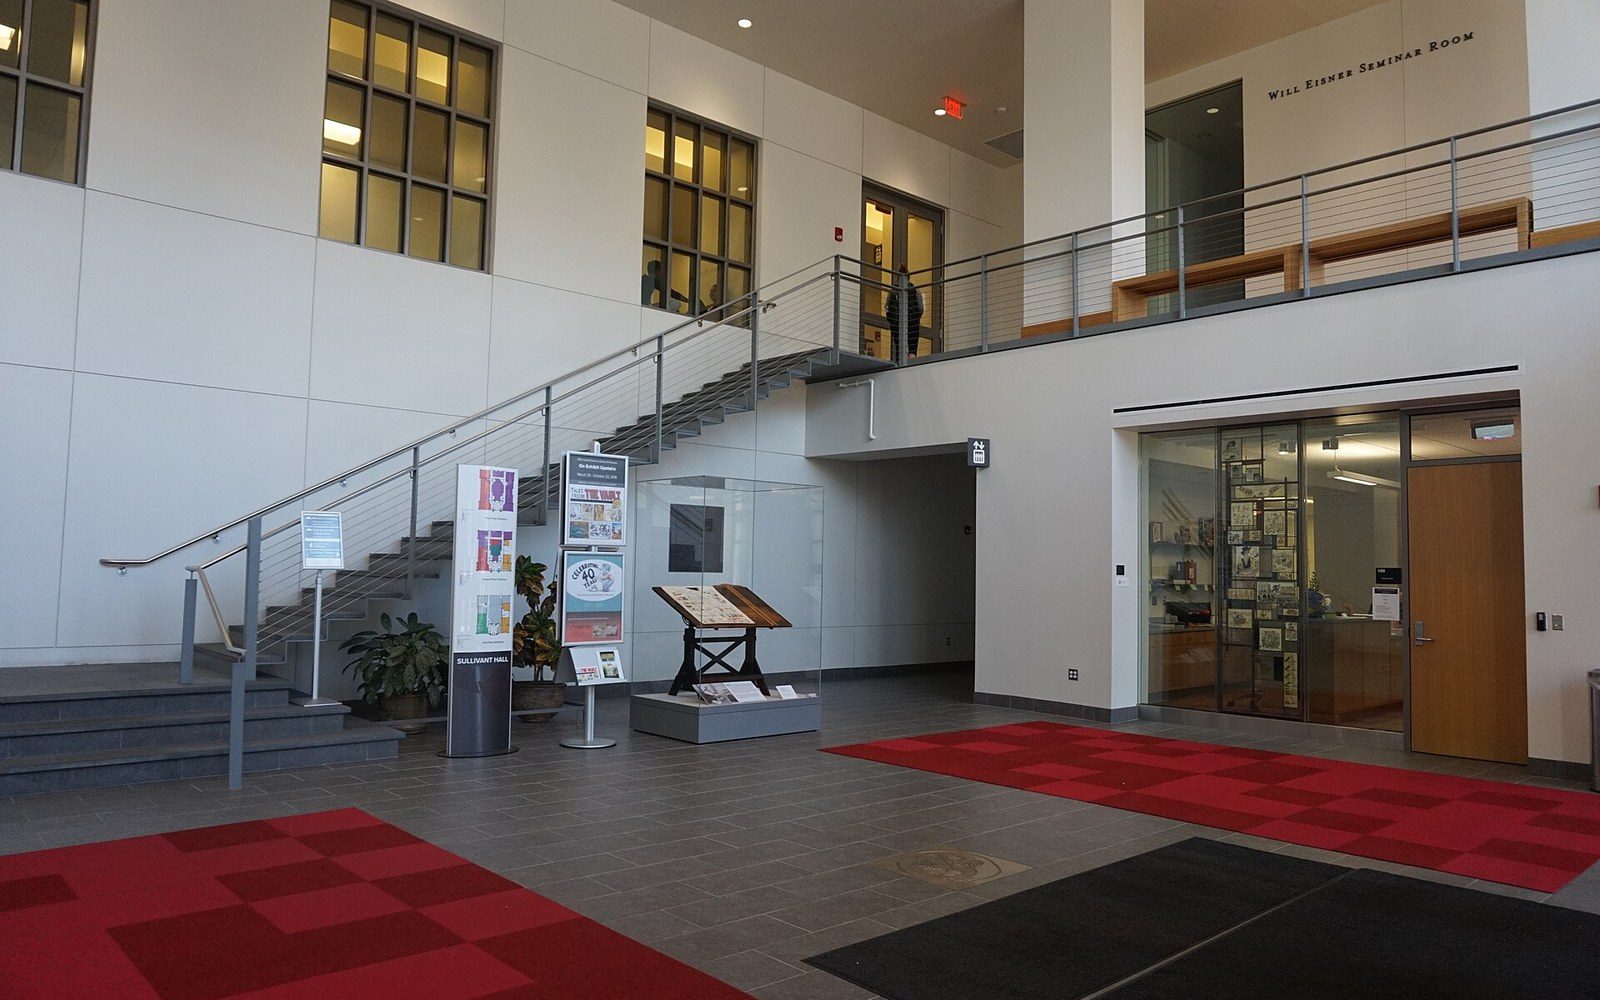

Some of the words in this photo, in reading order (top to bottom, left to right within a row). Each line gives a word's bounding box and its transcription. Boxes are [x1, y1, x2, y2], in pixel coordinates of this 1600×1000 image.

[1305, 69, 1353, 90] EISNER
[1359, 48, 1422, 73] SEMINAR
[1429, 31, 1475, 52] ROOM
[585, 488, 599, 499] THE
[599, 489, 621, 500] VAULT
[572, 563, 598, 580] CELEBRATING
[582, 568, 594, 582] 40
